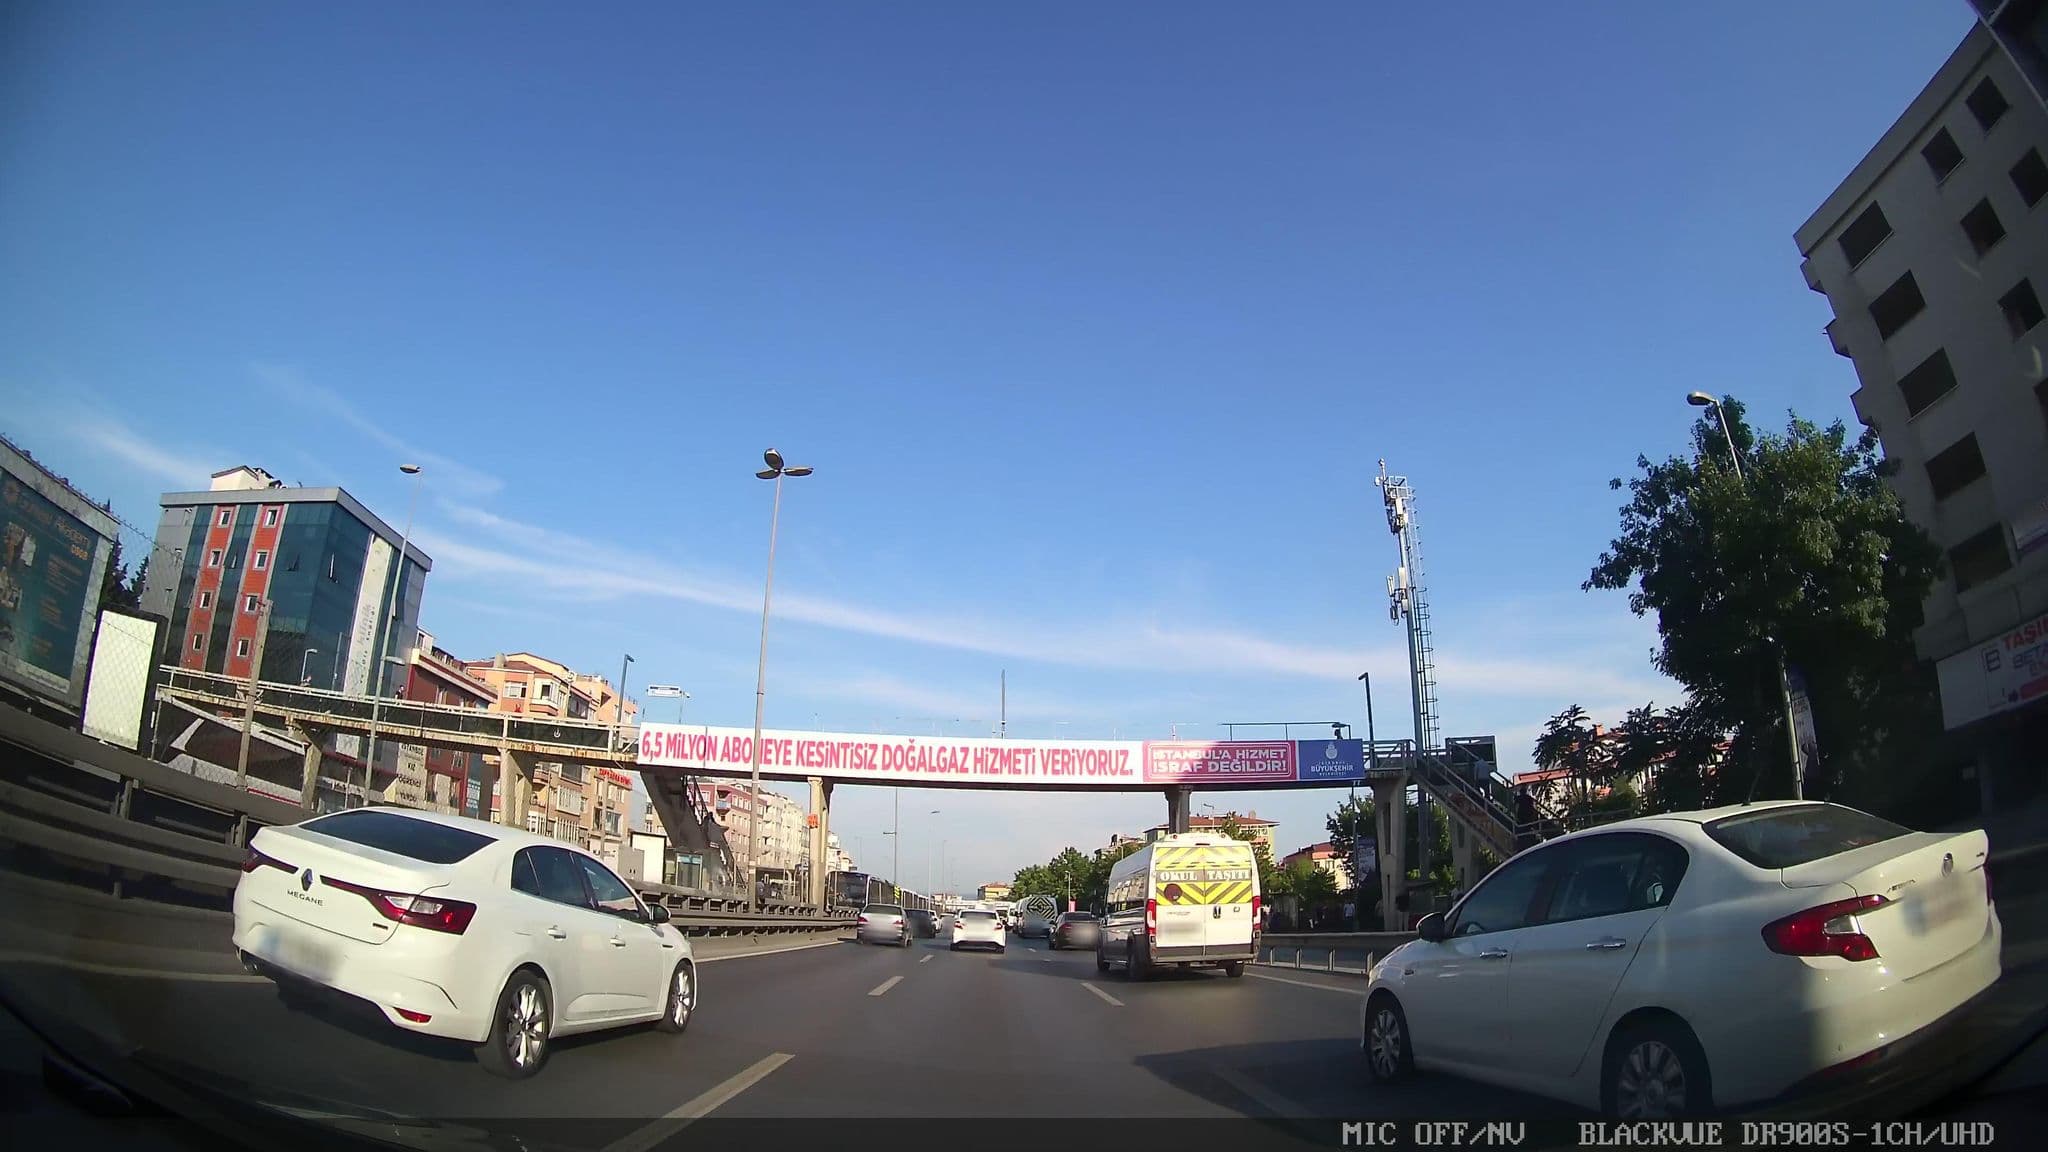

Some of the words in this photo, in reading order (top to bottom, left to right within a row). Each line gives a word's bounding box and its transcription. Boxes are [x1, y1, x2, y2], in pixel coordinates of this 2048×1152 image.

[642, 730, 662, 762] 6,5
[665, 731, 717, 761] MİLYON
[796, 739, 877, 770] KESİNTİSİZ
[881, 739, 969, 774] DOĞALGAZ
[973, 746, 1035, 775] HİZMETİ
[1040, 748, 1133, 776] VERİYORUZ.
[1236, 748, 1286, 759] HİZMET
[1207, 759, 1287, 773] DEĞİLDİR!
[1160, 870, 1198, 881] OKUL
[1207, 869, 1250, 881] TAŞITI
[287, 890, 323, 906] MEGANE
